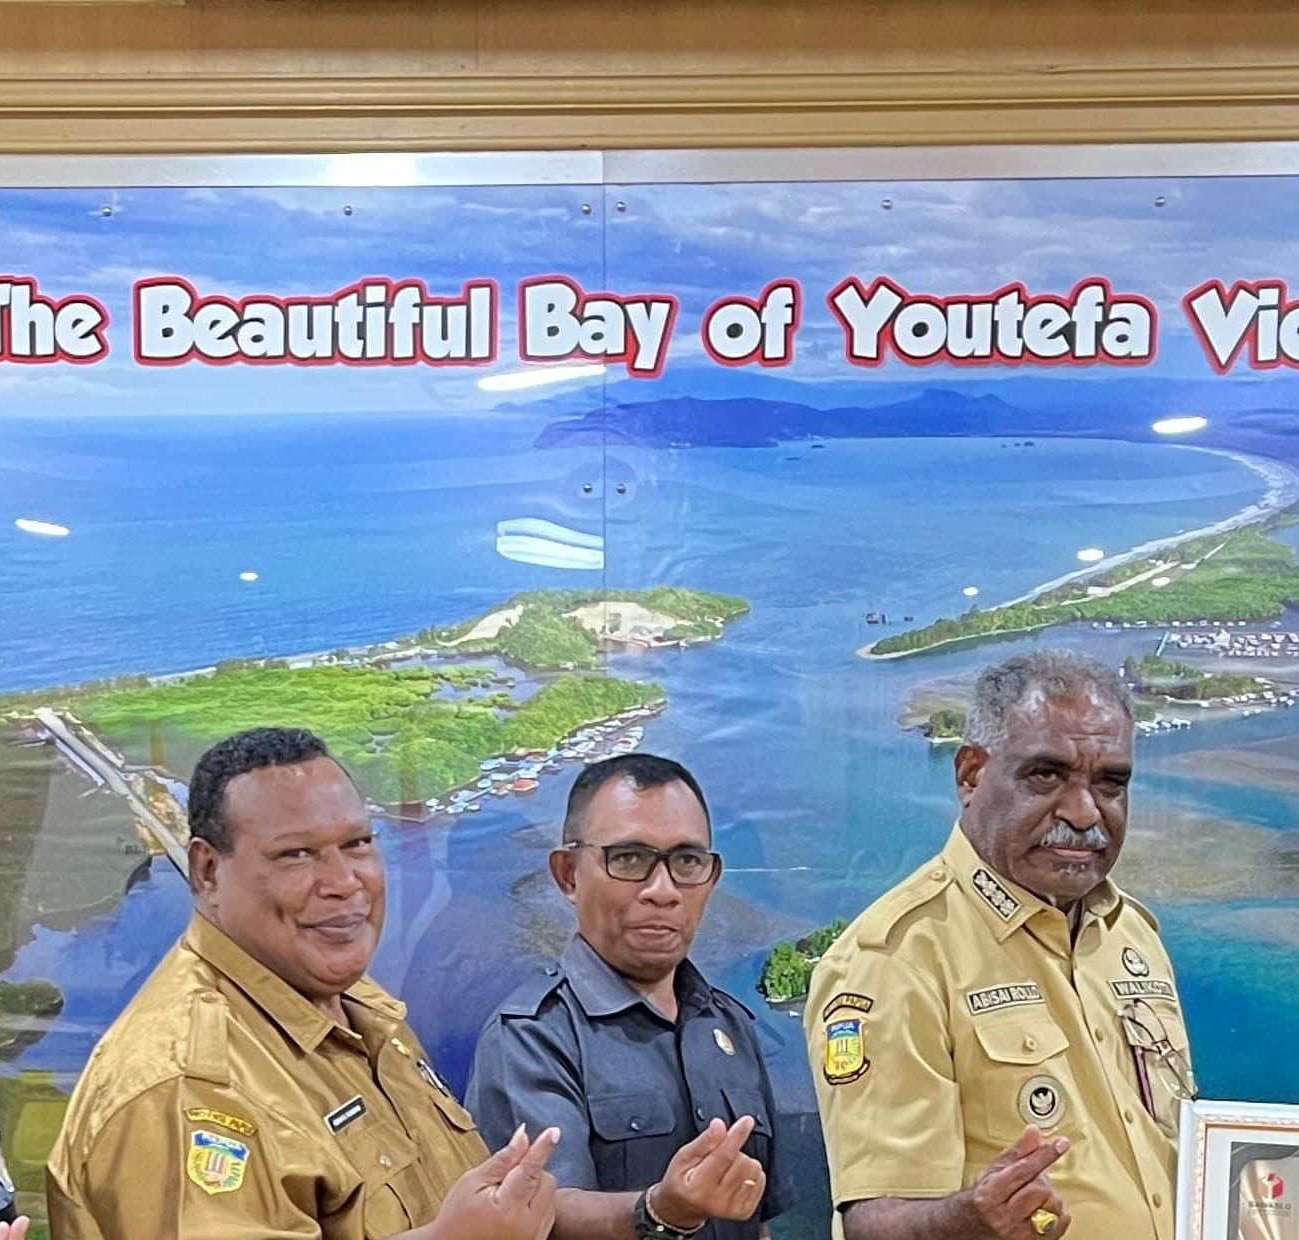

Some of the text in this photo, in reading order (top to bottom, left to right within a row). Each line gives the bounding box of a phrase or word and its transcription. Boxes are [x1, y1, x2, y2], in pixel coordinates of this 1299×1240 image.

[135, 278, 497, 364] Beautiful
[520, 277, 677, 376] Bay
[704, 279, 798, 366] of
[829, 277, 1155, 366] Youtefa
